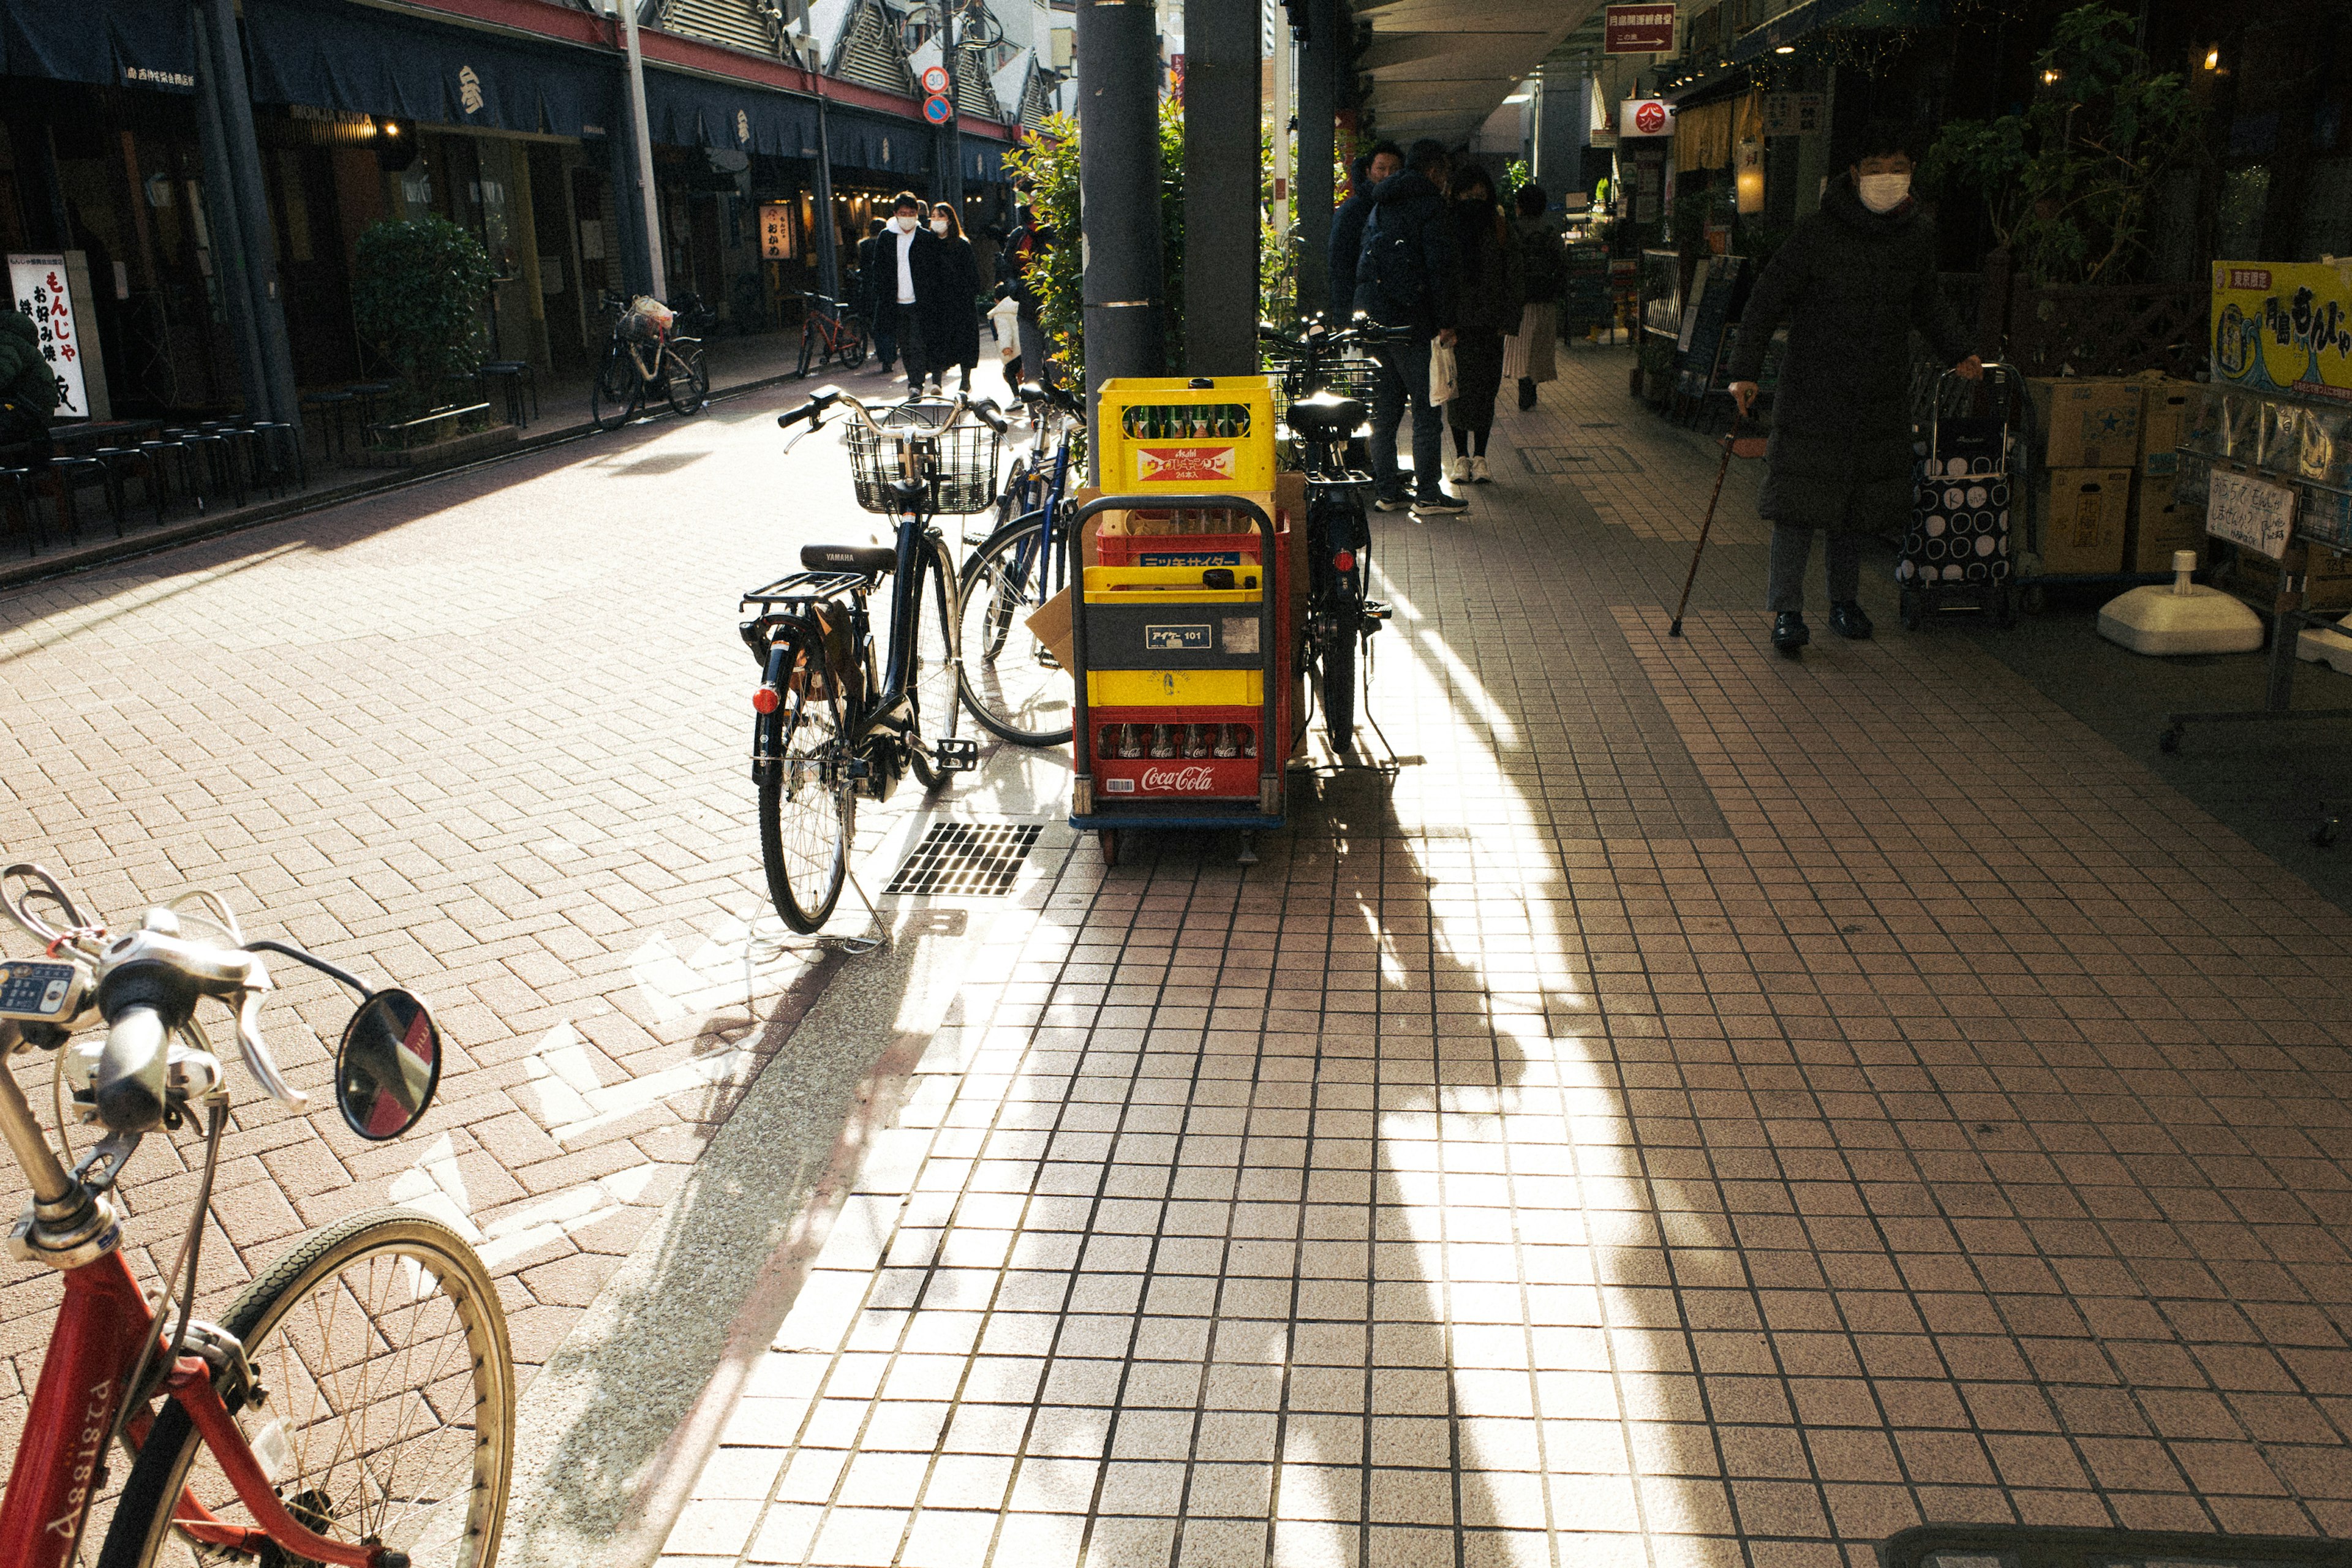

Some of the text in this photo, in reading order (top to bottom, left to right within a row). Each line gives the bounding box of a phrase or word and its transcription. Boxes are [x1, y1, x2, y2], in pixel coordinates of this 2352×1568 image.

[929, 74, 943, 86] 30
[768, 223, 780, 256] おかめ
[2234, 271, 2267, 288] 東京限定
[34, 286, 57, 361] お好み焼
[47, 271, 76, 362] もんじゃ
[1147, 458, 1226, 470] ウィルキンソン
[1175, 448, 1197, 458] Asahi
[1141, 767, 1215, 791] Coca-Cola
[45, 1379, 111, 1539] Assista
